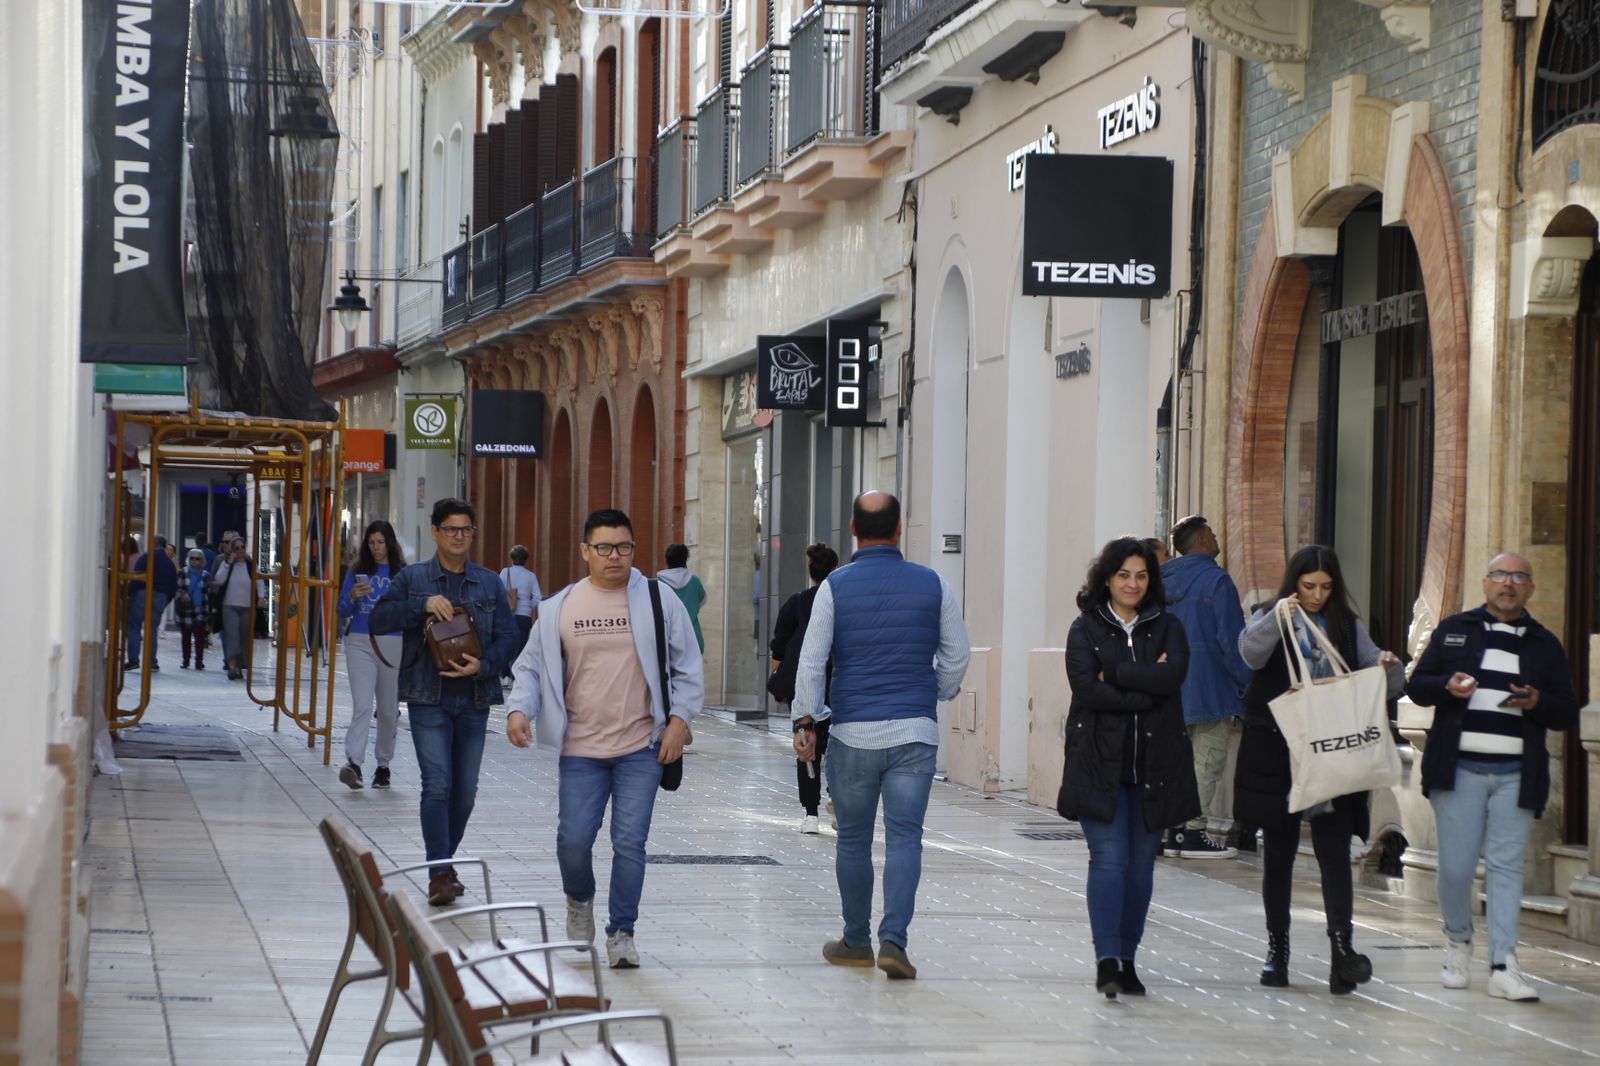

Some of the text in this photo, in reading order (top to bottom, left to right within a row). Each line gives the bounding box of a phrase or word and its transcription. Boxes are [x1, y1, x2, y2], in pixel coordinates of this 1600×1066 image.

[114, 118, 150, 150] Y
[113, 160, 150, 275] LOLA
[769, 364, 822, 392] BRUTAL
[475, 443, 536, 453] CALZEDONIA
[343, 460, 380, 472] orange
